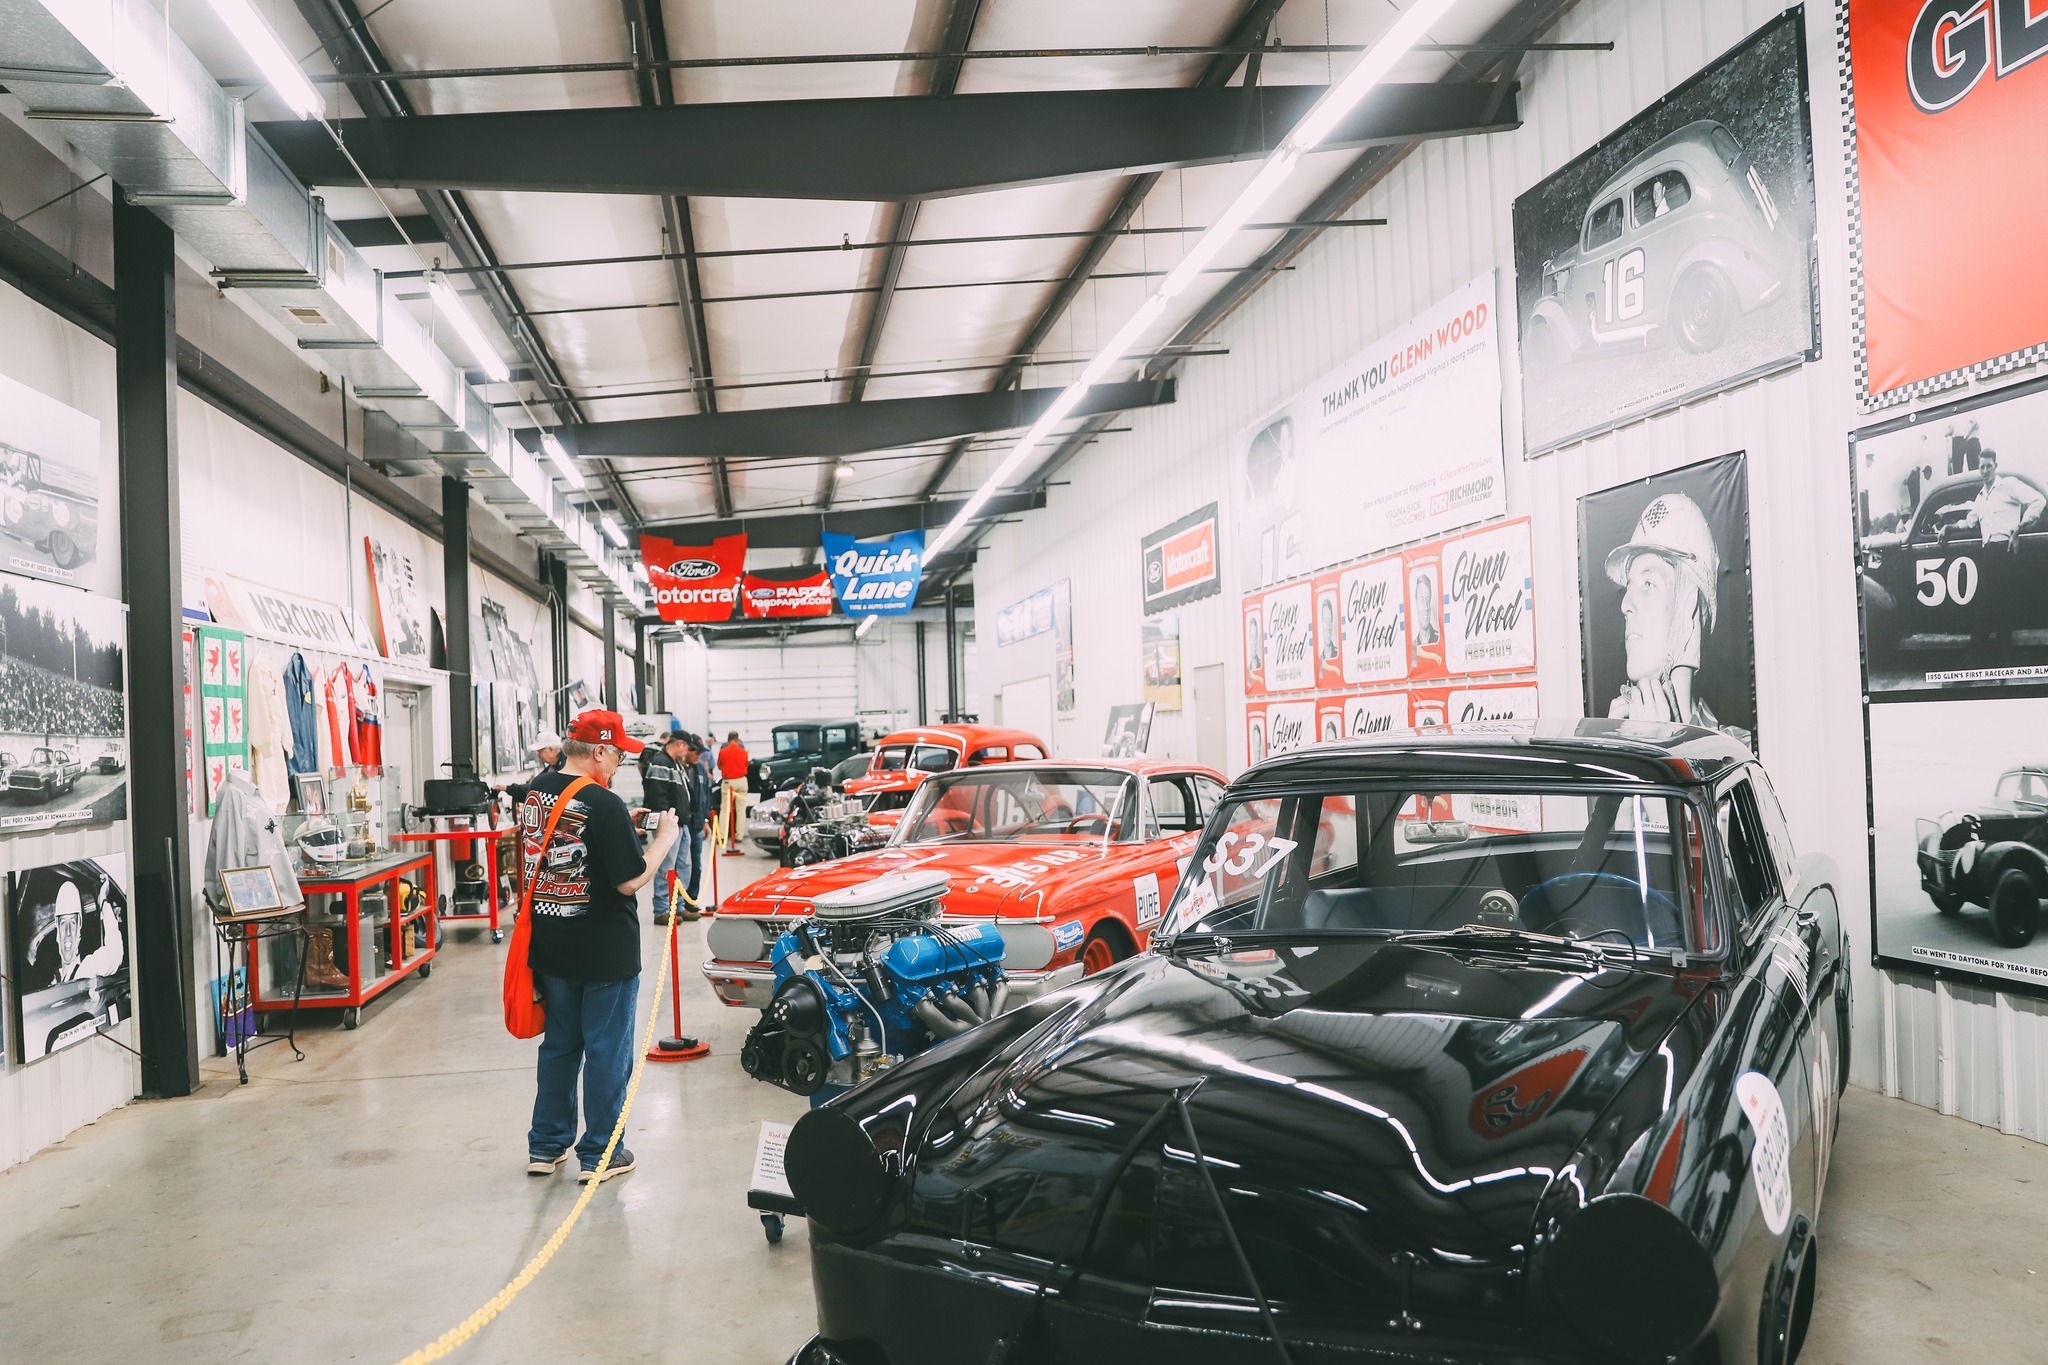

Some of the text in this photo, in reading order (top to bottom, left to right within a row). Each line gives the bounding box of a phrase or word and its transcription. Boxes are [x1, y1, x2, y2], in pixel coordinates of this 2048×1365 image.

[1603, 247, 1645, 324] 16
[1322, 303, 1487, 417] THANK YOU GLENN WOOD
[1397, 380, 1412, 395] helped
[1412, 374, 1426, 387] shape
[1426, 358, 1449, 377] Virginia's
[1450, 352, 1465, 367] racing
[1466, 340, 1487, 357] history.
[1449, 475, 1494, 502] RICHMOND
[1471, 491, 1493, 503] RACEWAY
[672, 560, 719, 578] Ford
[836, 549, 918, 576] Quick
[1167, 539, 1209, 578] Motorcraft
[1452, 550, 1510, 603] Glenn
[776, 586, 831, 598] PARTS
[842, 577, 914, 601] Lane
[1916, 556, 1978, 606] 50
[248, 591, 342, 644] MERCURY
[1269, 601, 1299, 639] Glenn
[1347, 579, 1389, 623] Glenn
[1464, 582, 1523, 640] Wood
[1276, 626, 1307, 666] Wood
[1357, 608, 1398, 655] Wood
[1943, 672, 1963, 680] GLEN'S
[1984, 669, 2015, 677] RACECAR
[600, 729, 612, 740] 21
[1272, 713, 1303, 750] Glenn
[524, 804, 537, 828] 21
[1203, 832, 1298, 879] S37
[1138, 891, 1159, 921] PURE
[1912, 947, 1928, 955] GLEN
[1929, 950, 1947, 959] WENT
[1958, 955, 1989, 966] DAYTONA
[1991, 961, 2004, 969] FOR
[2006, 964, 2028, 973] YEARS
